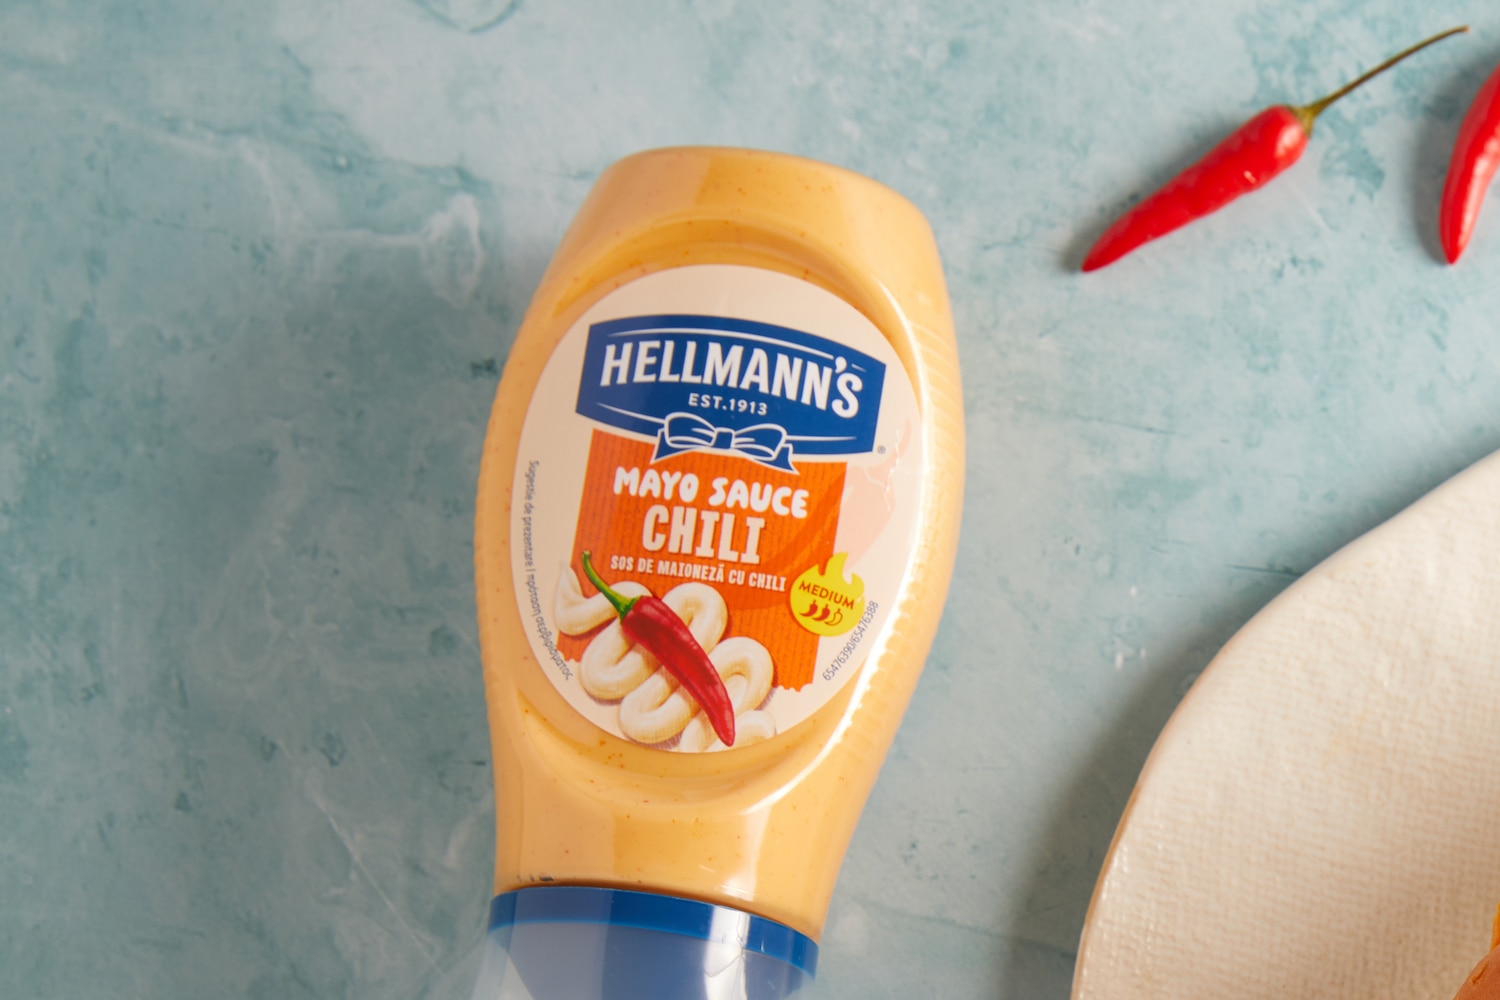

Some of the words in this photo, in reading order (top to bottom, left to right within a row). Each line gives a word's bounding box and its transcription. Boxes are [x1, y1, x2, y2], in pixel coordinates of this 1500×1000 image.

[600, 340, 863, 419] HELLMANN'S
[525, 460, 540, 500] Sugestie
[613, 466, 699, 502] MAYO
[709, 477, 809, 519] SAUCE
[523, 502, 534, 515] de
[522, 517, 534, 567] prezentare
[642, 504, 766, 564] CHILI
[610, 555, 633, 573] SOS
[637, 558, 653, 574] DE
[657, 560, 724, 583] MAIONEZĂ
[728, 571, 744, 586] CU
[748, 573, 787, 592] CHILI
[799, 581, 855, 609] MEDIUM
